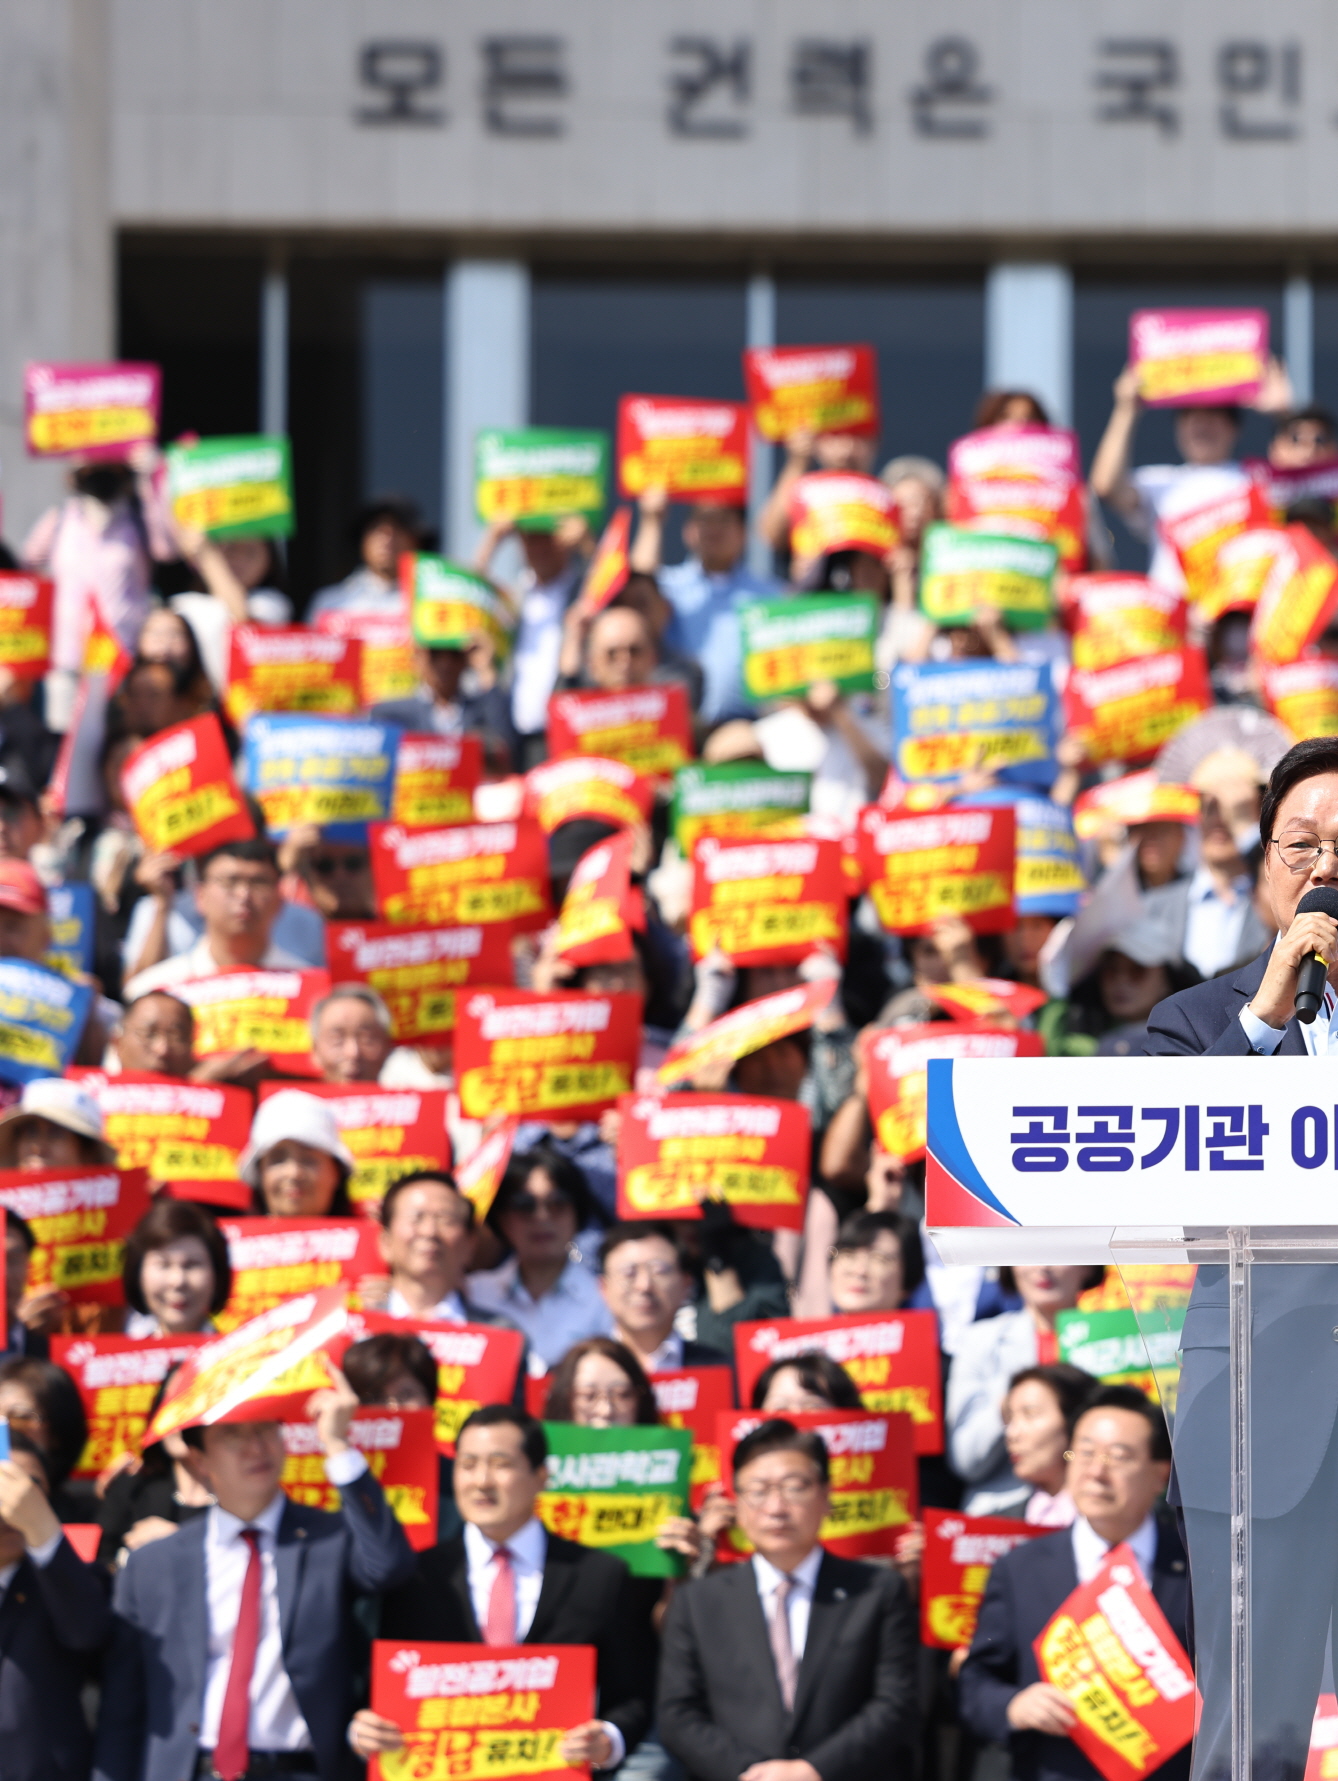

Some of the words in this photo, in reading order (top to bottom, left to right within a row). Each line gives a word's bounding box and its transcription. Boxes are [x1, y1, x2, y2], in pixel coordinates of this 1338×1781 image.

[352, 33, 570, 142] 모든
[665, 34, 997, 146] 권력은
[1010, 1104, 1270, 1173] 공공기관
